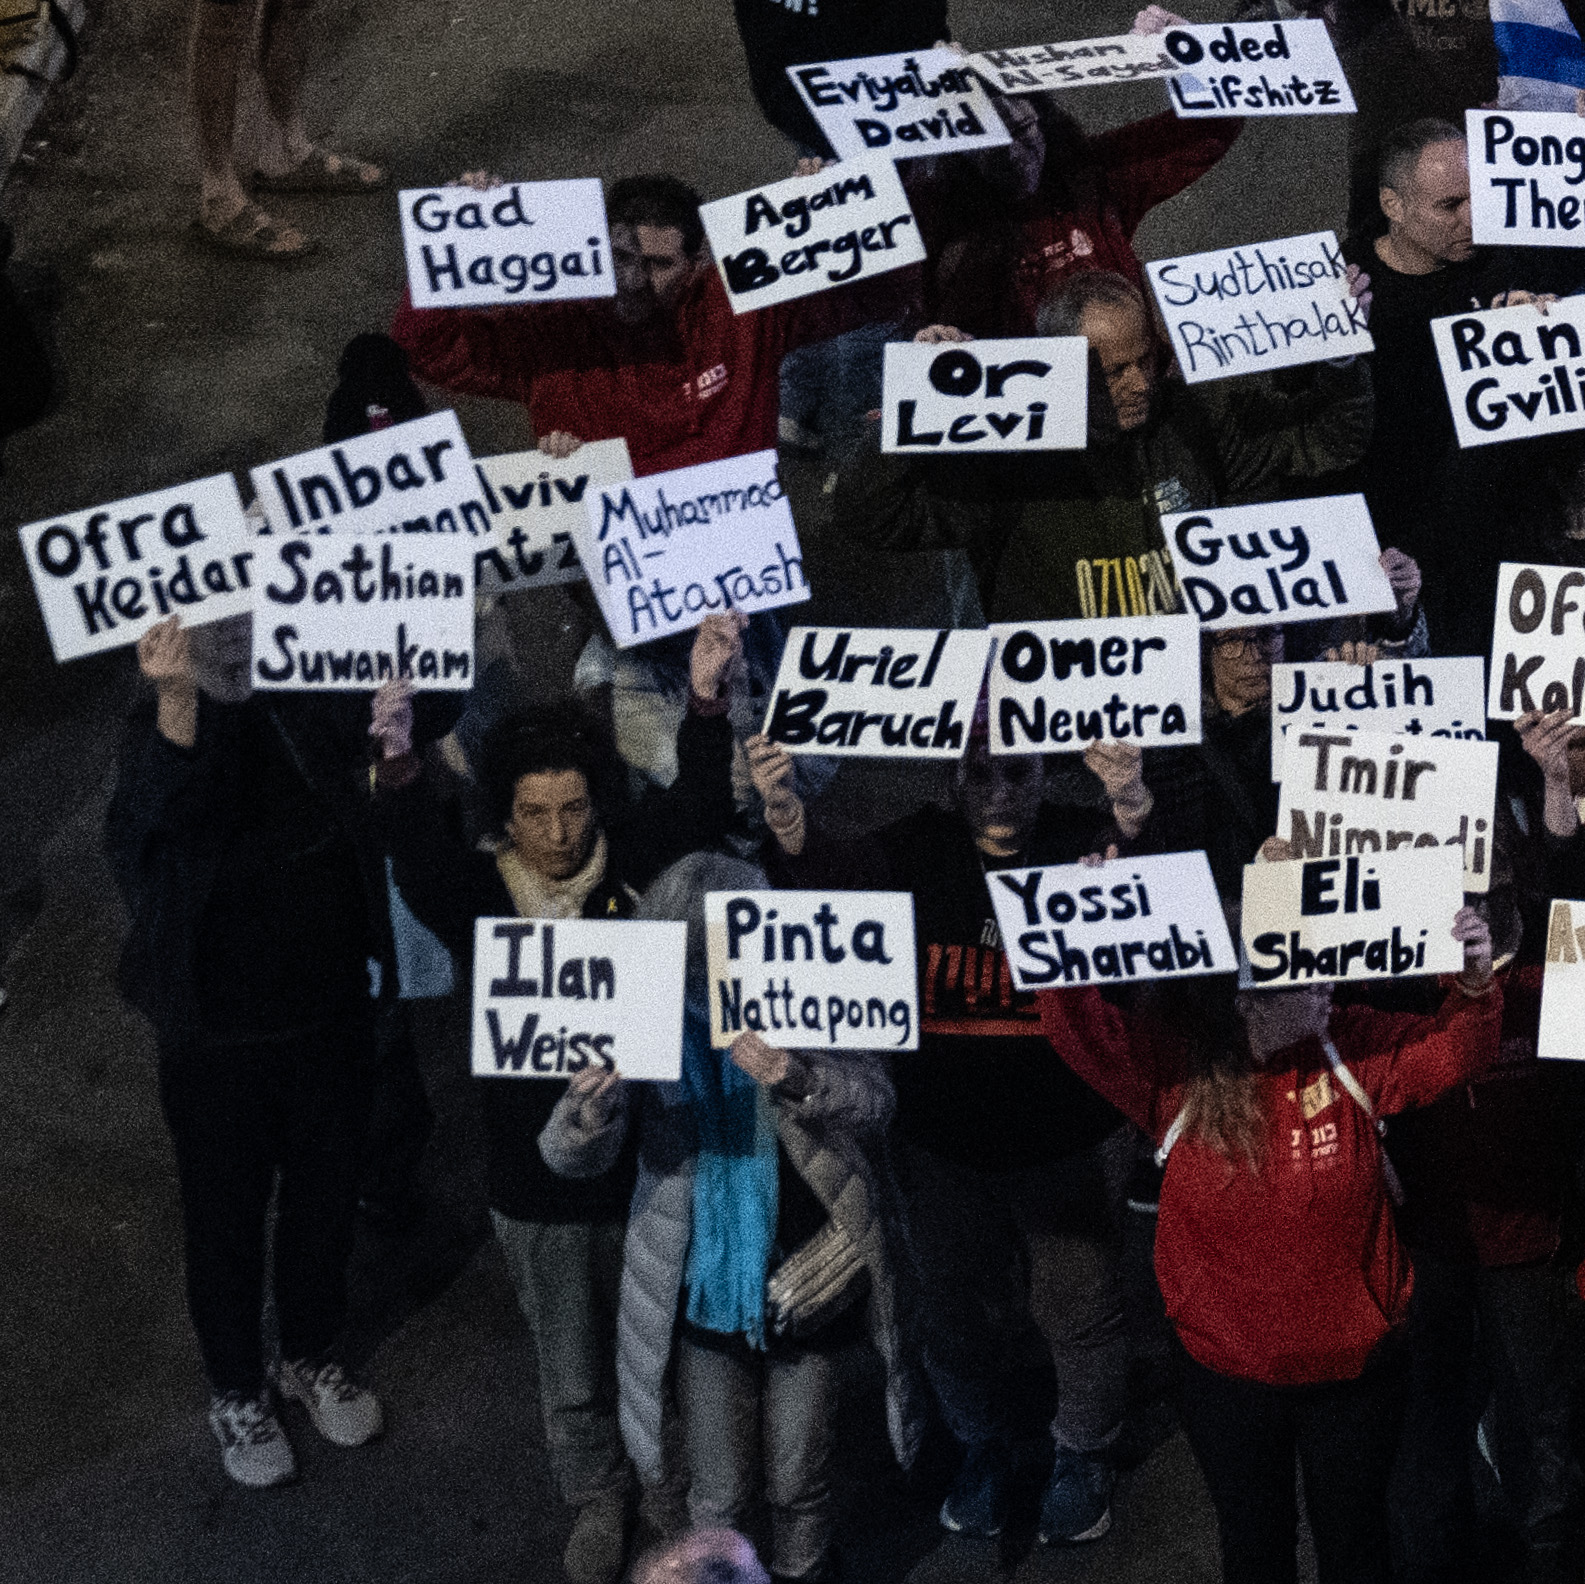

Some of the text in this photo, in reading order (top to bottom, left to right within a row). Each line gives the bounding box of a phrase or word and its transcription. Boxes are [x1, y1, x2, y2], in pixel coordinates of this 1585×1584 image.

[1165, 22, 1290, 66] Oded
[854, 102, 986, 149] David
[412, 187, 534, 233] Gad
[743, 173, 875, 238] Agam
[422, 238, 604, 295] Haggai
[720, 212, 913, 296] Berger
[928, 349, 1053, 398] Or
[1450, 317, 1583, 373] Ran
[273, 439, 454, 528] Inbar
[37, 502, 208, 579] Ofra
[1173, 515, 1310, 572] Guy
[266, 540, 465, 605] Sathian
[1181, 559, 1349, 622] Dalal
[797, 629, 953, 690] Uriel
[1001, 630, 1167, 684] Omer
[1278, 663, 1435, 715] Judih
[764, 688, 964, 752] Baruch
[999, 692, 1189, 748] Neutra
[1298, 732, 1439, 801] Tmir
[996, 872, 1151, 926] Yossi
[1300, 857, 1382, 917] Eli
[724, 895, 894, 966] Pinta
[1015, 924, 1215, 988] Sharabi
[1250, 925, 1429, 984] Sharabi
[488, 923, 617, 1001] Ilan
